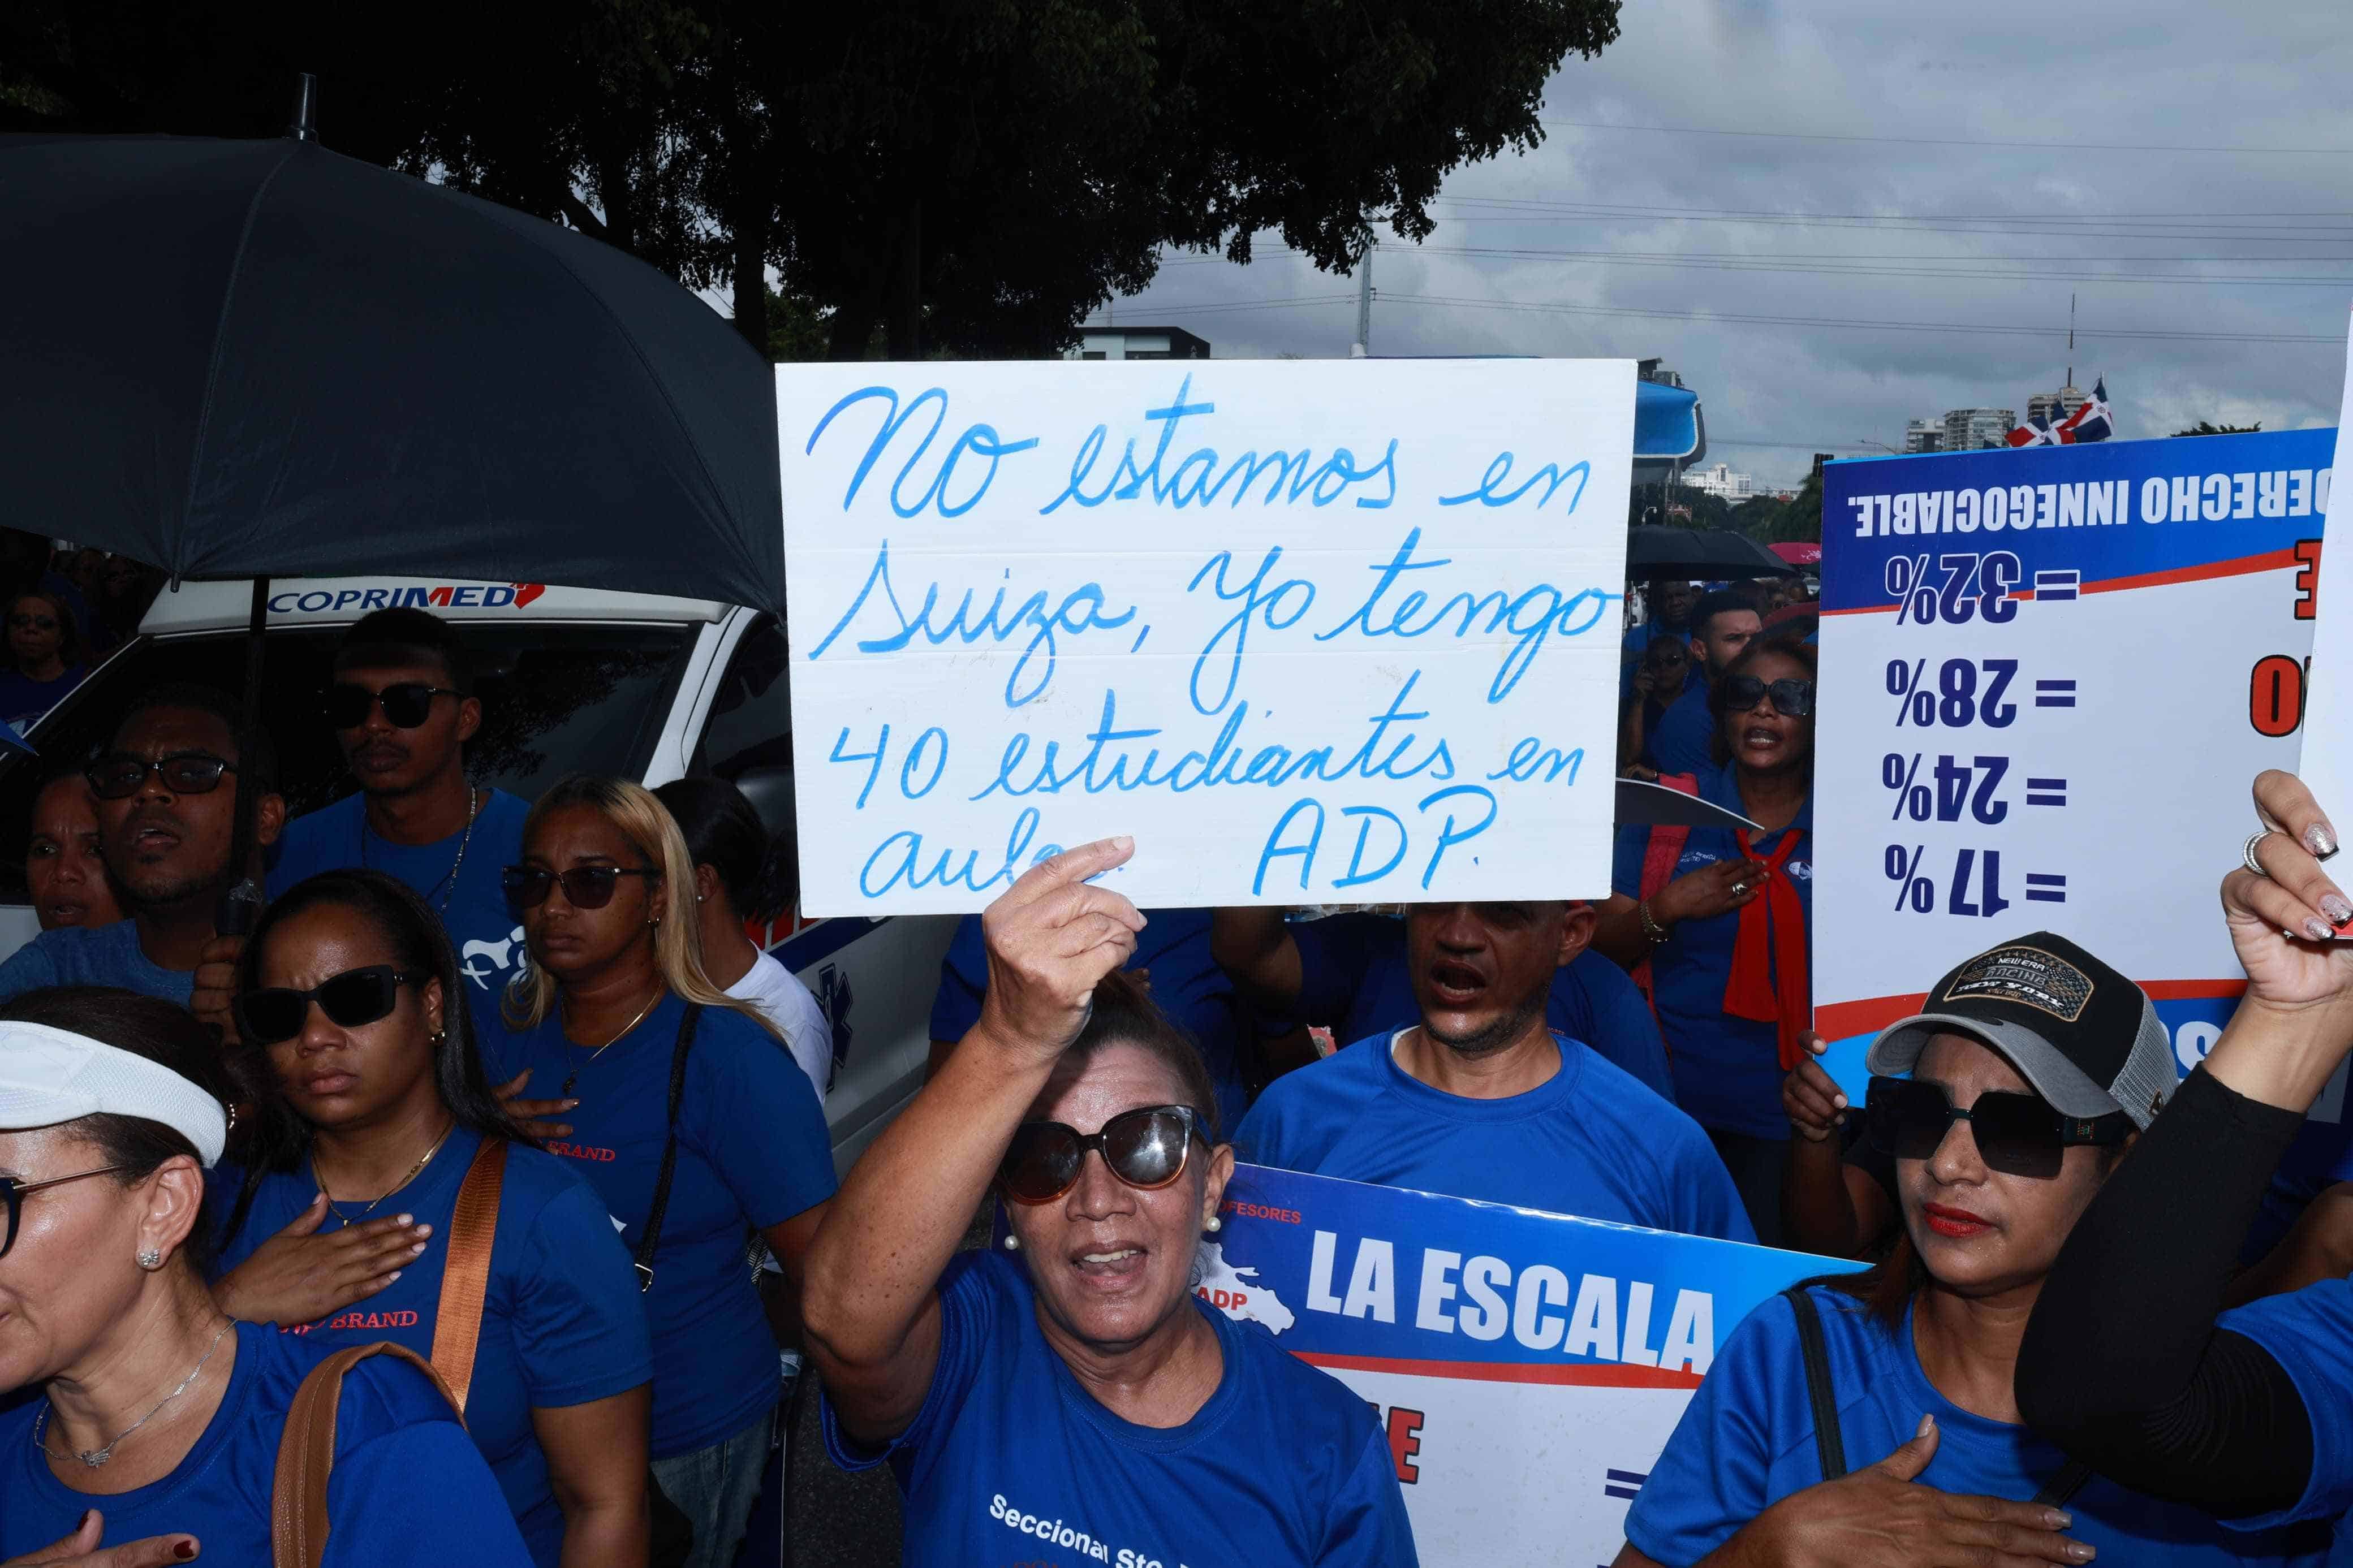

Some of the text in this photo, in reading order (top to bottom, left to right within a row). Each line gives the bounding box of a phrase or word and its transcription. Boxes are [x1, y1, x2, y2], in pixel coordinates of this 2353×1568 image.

[805, 371, 1591, 518] No estamos en
[1847, 480, 2129, 538] INNEGOCIABLE.
[268, 585, 515, 613] COPRIMED
[1188, 545, 1316, 715] Yo
[1313, 526, 1623, 704] tengo
[1885, 550, 2021, 625] 32%
[1886, 659, 2018, 728] 28%
[829, 669, 1584, 809] 40 estudiantes en
[1882, 753, 2009, 824] 24%
[1253, 784, 1497, 896] ADP.
[2022, 960, 2045, 971] ERA
[330, 1310, 419, 1329] BRAND
[1306, 1229, 1715, 1375] LA ESCALA
[989, 1493, 1109, 1565] Seccional
